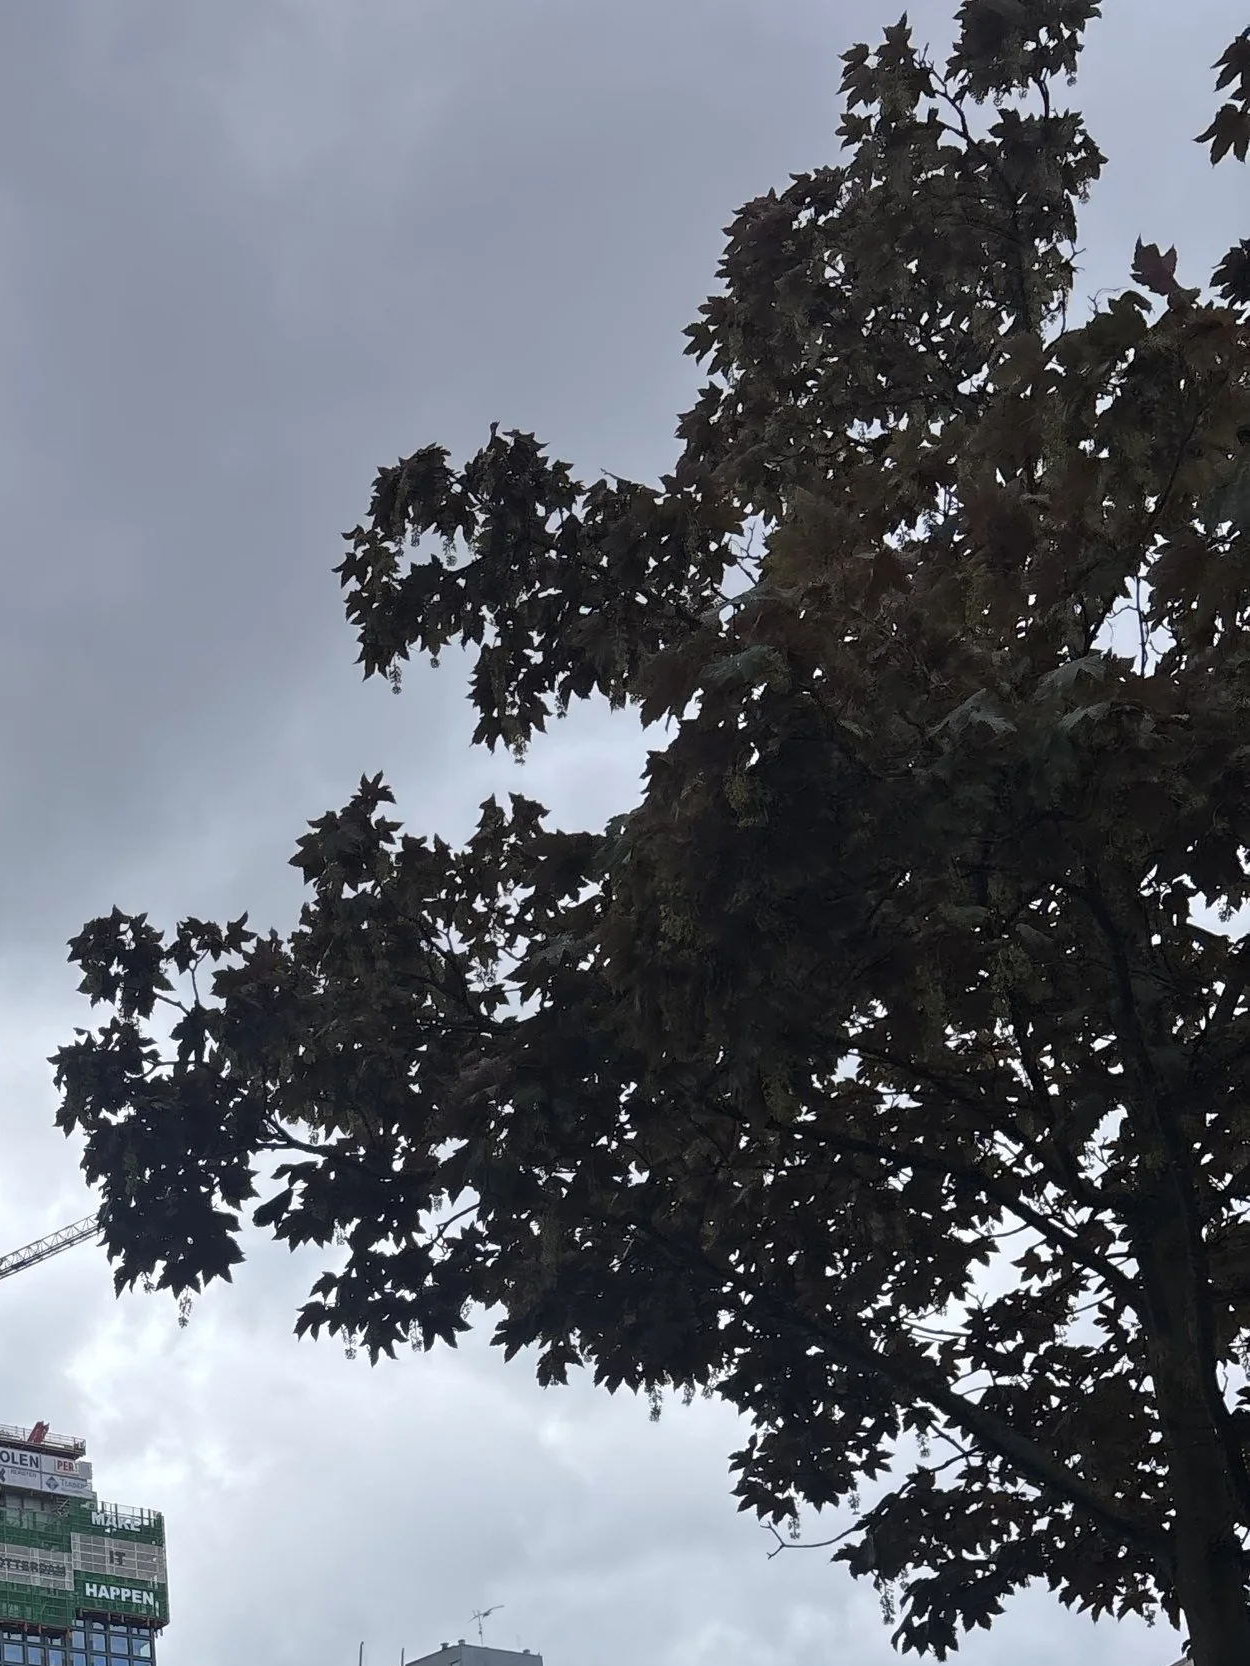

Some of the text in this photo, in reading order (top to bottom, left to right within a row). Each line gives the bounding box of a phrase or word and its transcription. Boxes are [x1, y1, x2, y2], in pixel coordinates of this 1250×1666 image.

[91, 1511, 141, 1532] MAKE
[109, 1550, 126, 1566] IT
[85, 1582, 154, 1606] HAPPEN
